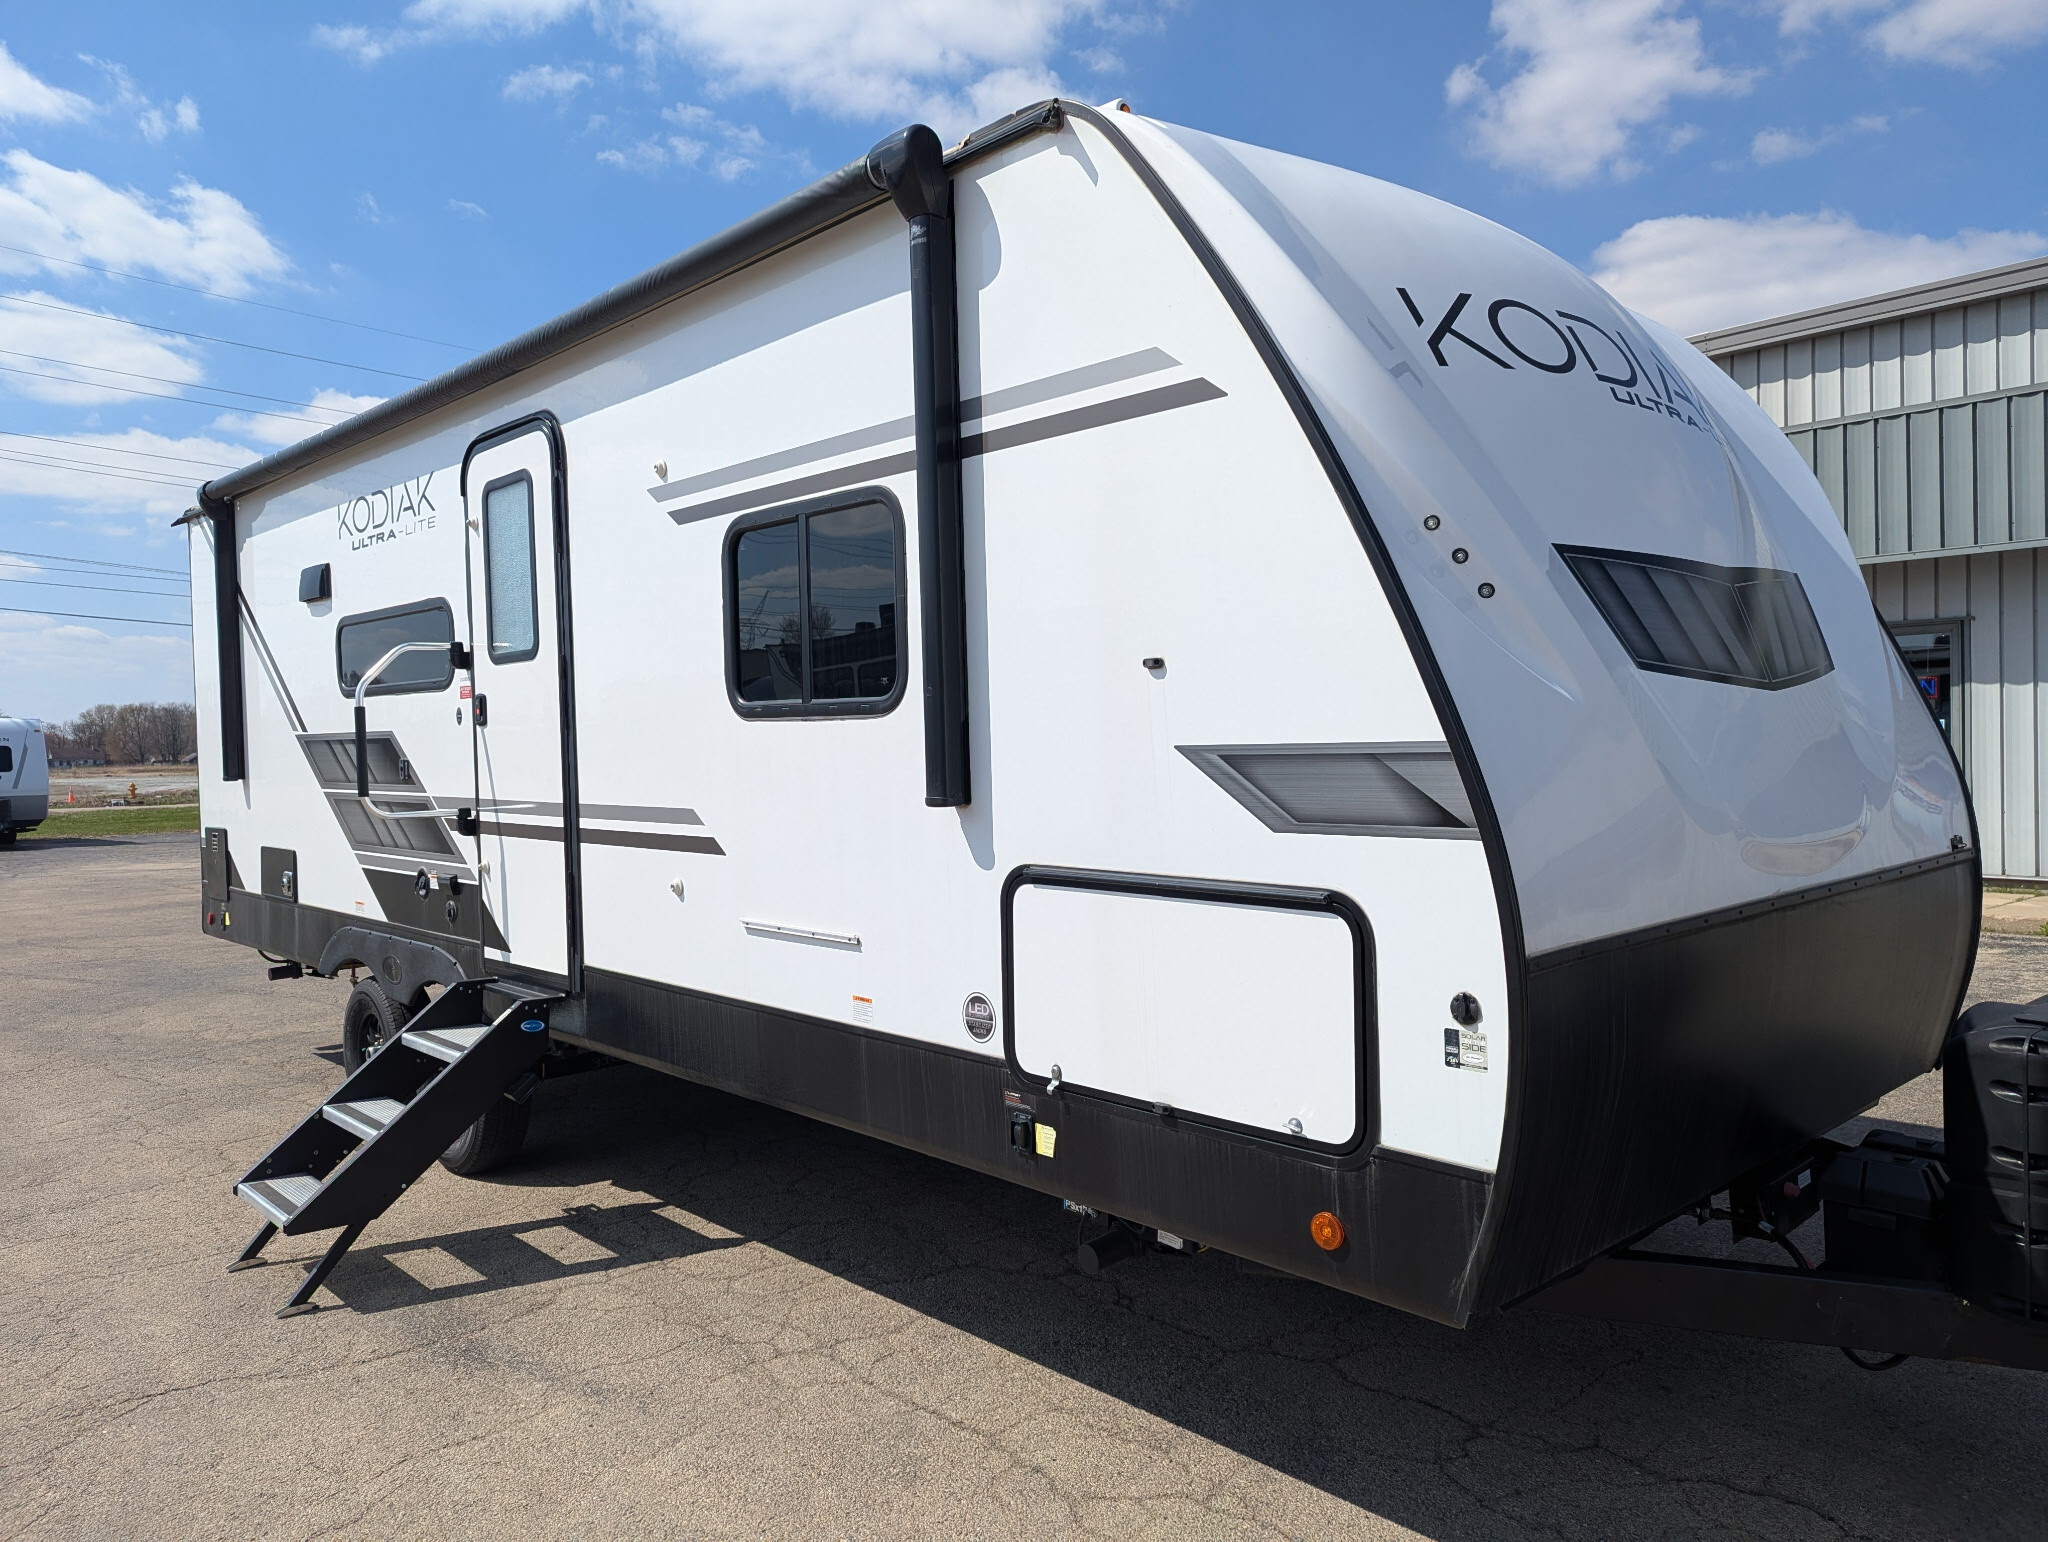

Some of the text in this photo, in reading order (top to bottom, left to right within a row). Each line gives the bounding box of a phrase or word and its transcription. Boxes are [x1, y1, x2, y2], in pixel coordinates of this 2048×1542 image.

[337, 470, 436, 540] KODIAK
[352, 515, 436, 551] ULTRA-LITE
[968, 1001, 990, 1016] LED
[1461, 1033, 1486, 1041] SOLAR
[1461, 1043, 1487, 1053] SIDE
